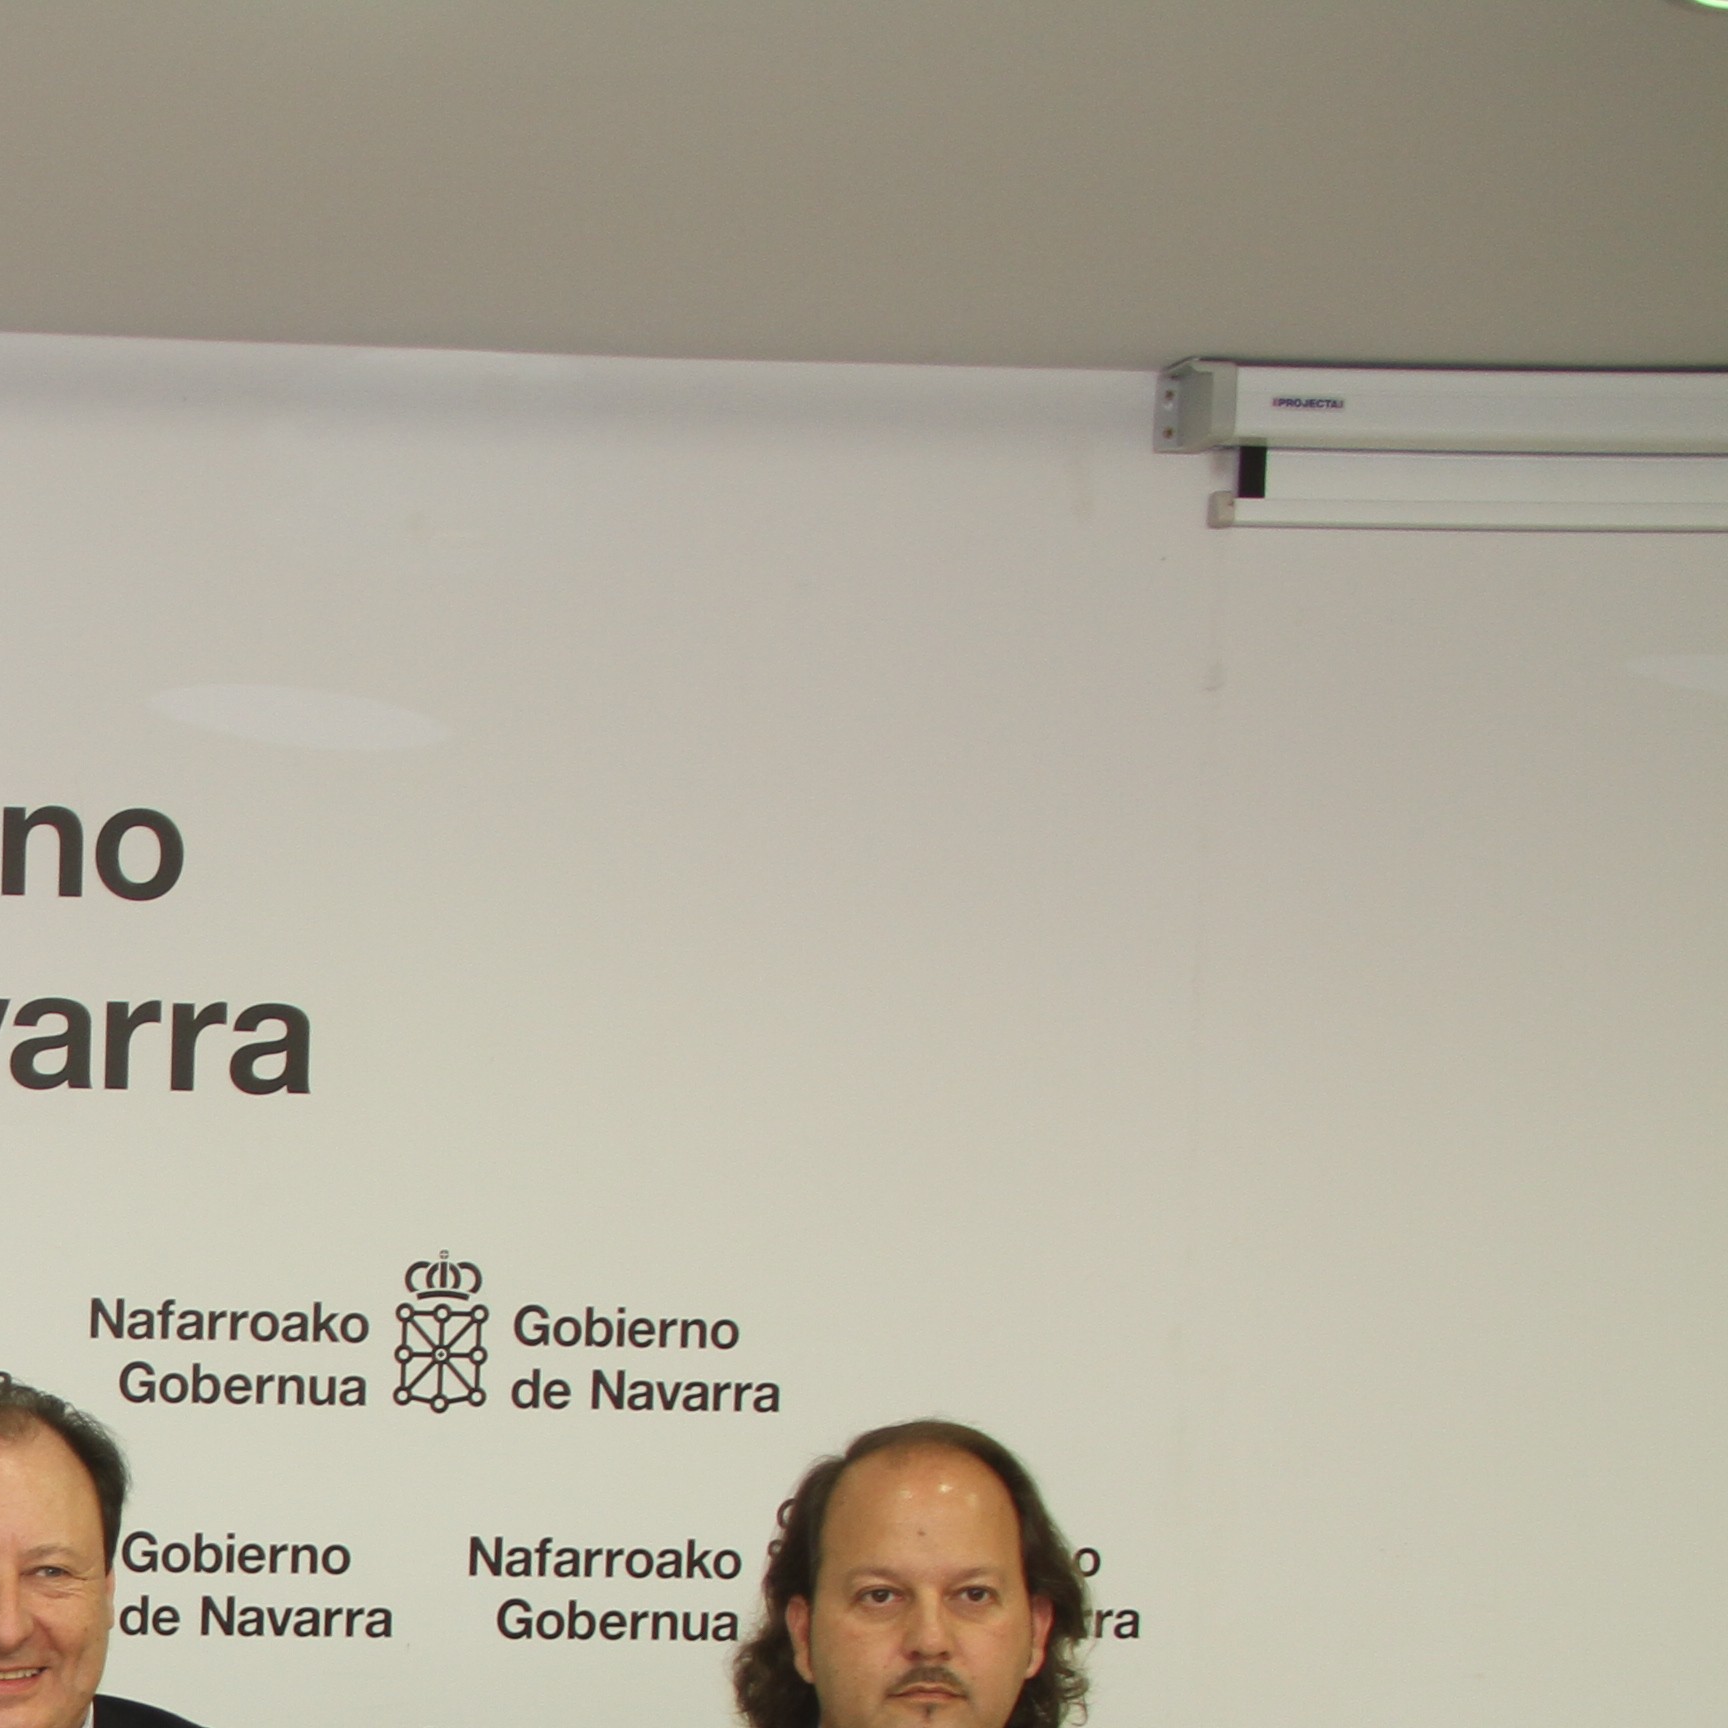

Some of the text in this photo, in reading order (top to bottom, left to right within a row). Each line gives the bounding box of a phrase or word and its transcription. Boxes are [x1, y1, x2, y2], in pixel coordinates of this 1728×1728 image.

[1276, 398, 1340, 409] PROJECTA
[90, 1297, 369, 1344] Nafarroako
[513, 1304, 740, 1350] Gobierno
[119, 1360, 366, 1407] Gobernua
[511, 1368, 780, 1413] de Navarra
[121, 1530, 351, 1575] Gobierno
[469, 1536, 742, 1580] Nafarroako
[119, 1594, 392, 1639] de Navarra
[496, 1598, 738, 1642] Gobernua
